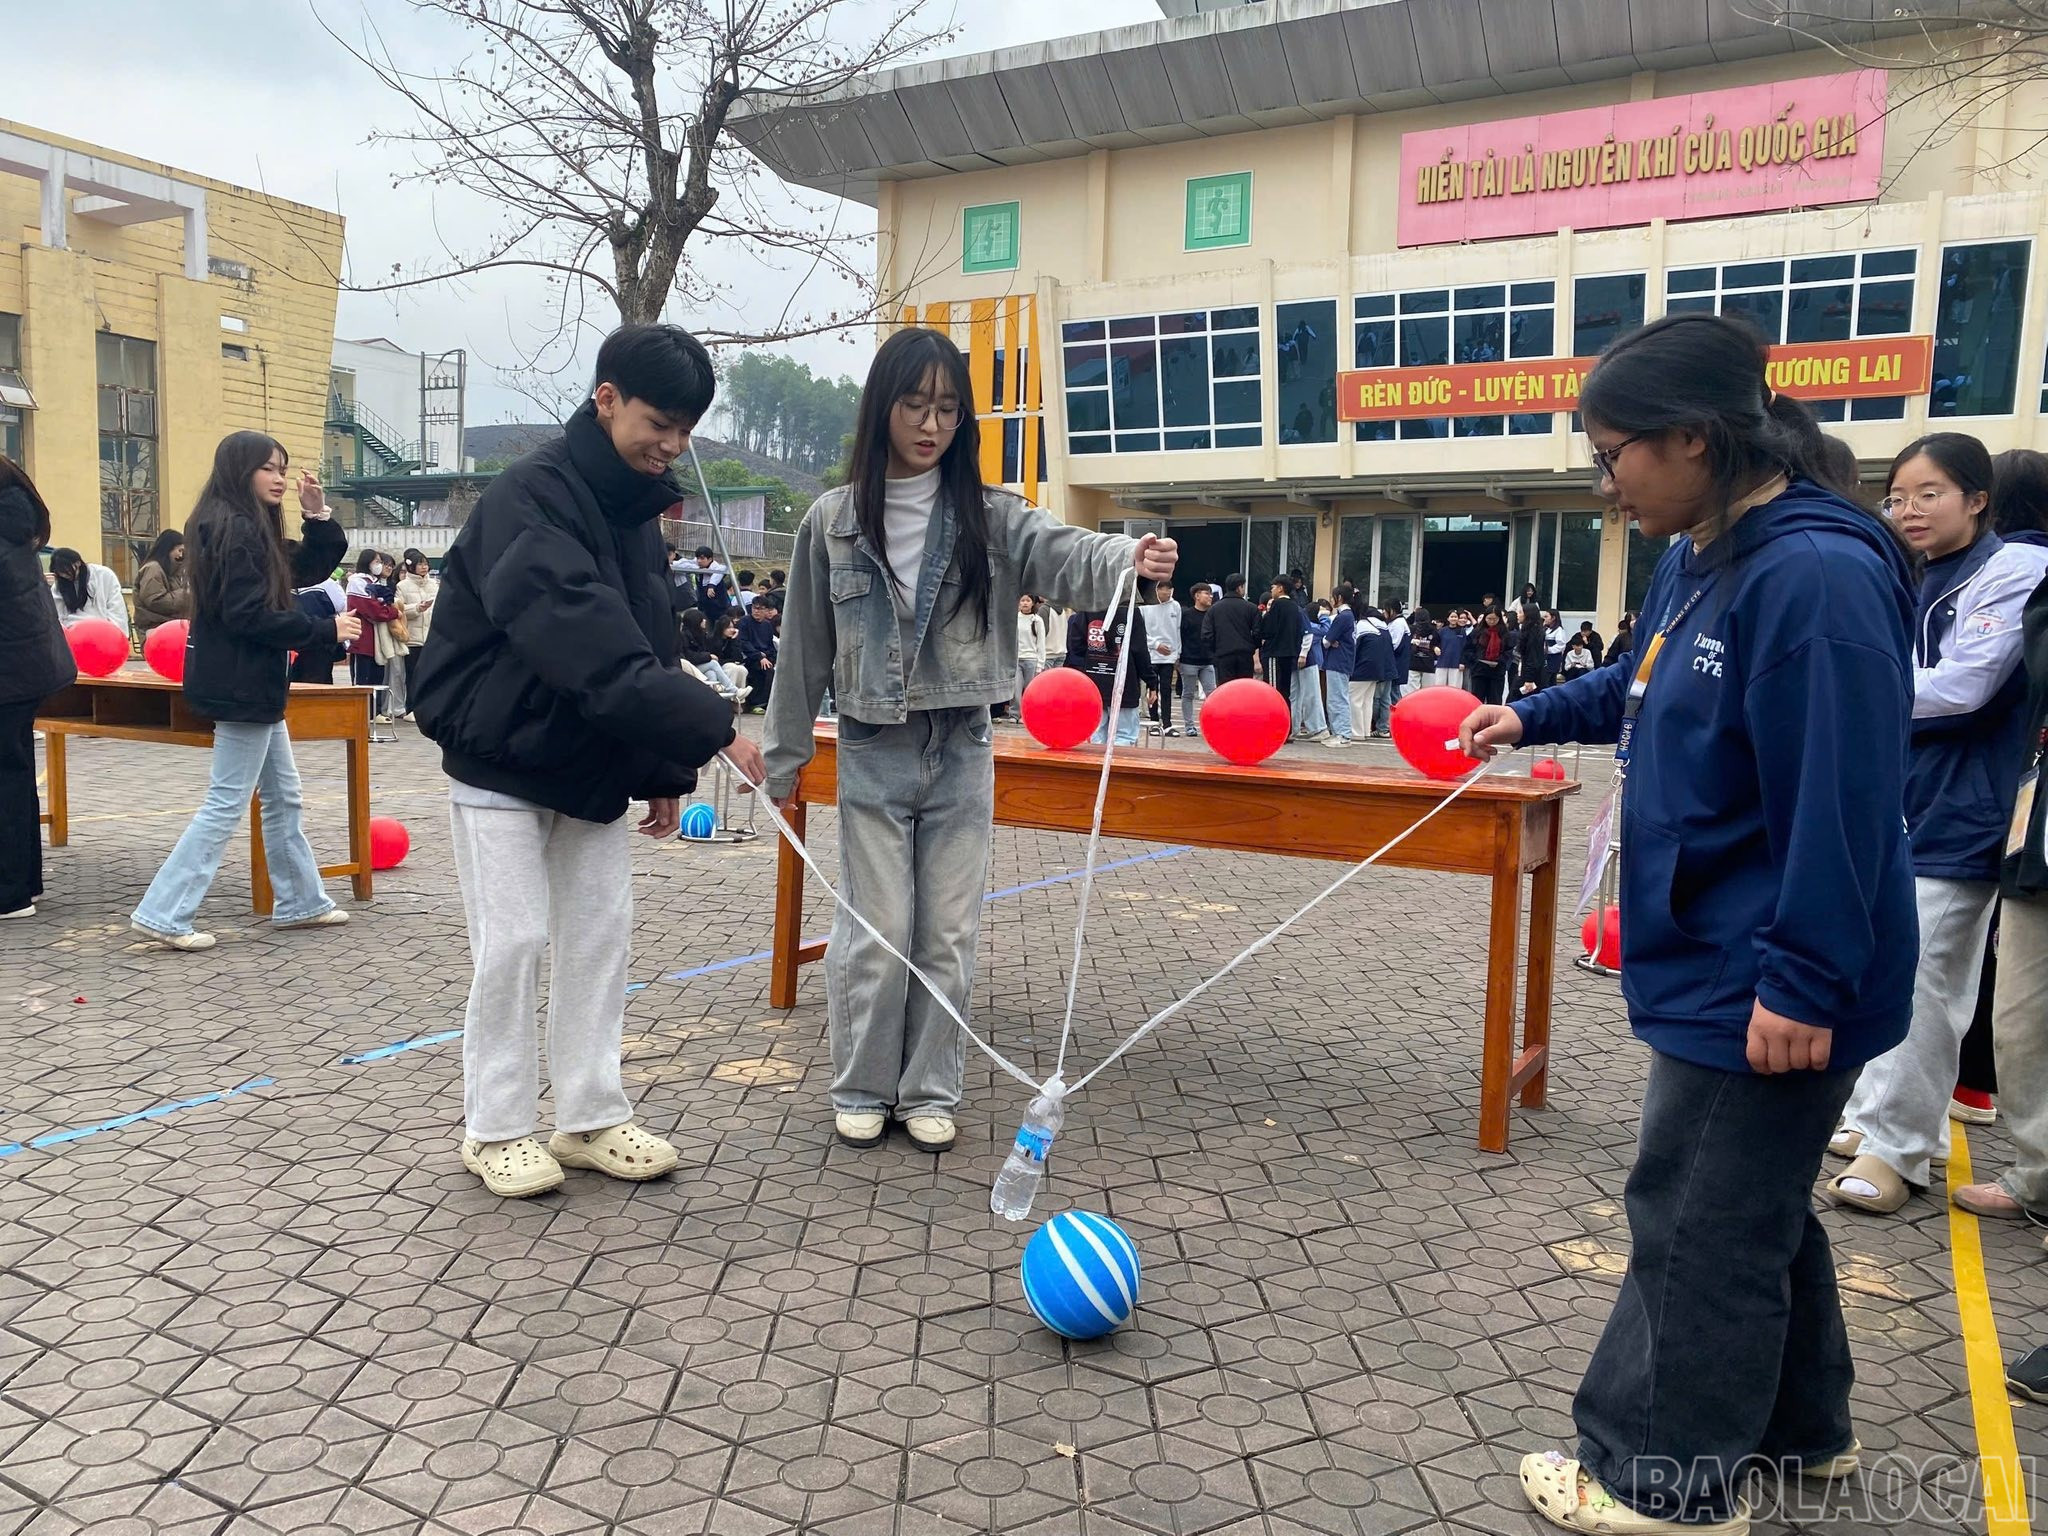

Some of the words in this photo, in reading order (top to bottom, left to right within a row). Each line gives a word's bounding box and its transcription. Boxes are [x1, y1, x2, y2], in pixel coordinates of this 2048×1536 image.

[1417, 146, 1465, 204] HIỀN
[1471, 148, 1506, 199] TÀI
[1510, 143, 1535, 195] LÀ
[1541, 133, 1633, 191] NGUYÊN
[1637, 125, 1682, 180] KHÍ
[1684, 112, 1733, 175] CỦA
[1739, 101, 1806, 173] QUỐC
[1813, 112, 1857, 160] GIA
[1360, 379, 1402, 408] RÈN
[1408, 375, 1452, 405] ĐỨC
[1474, 371, 1545, 406] LUYỆN
[1858, 354, 1902, 383] LAI
